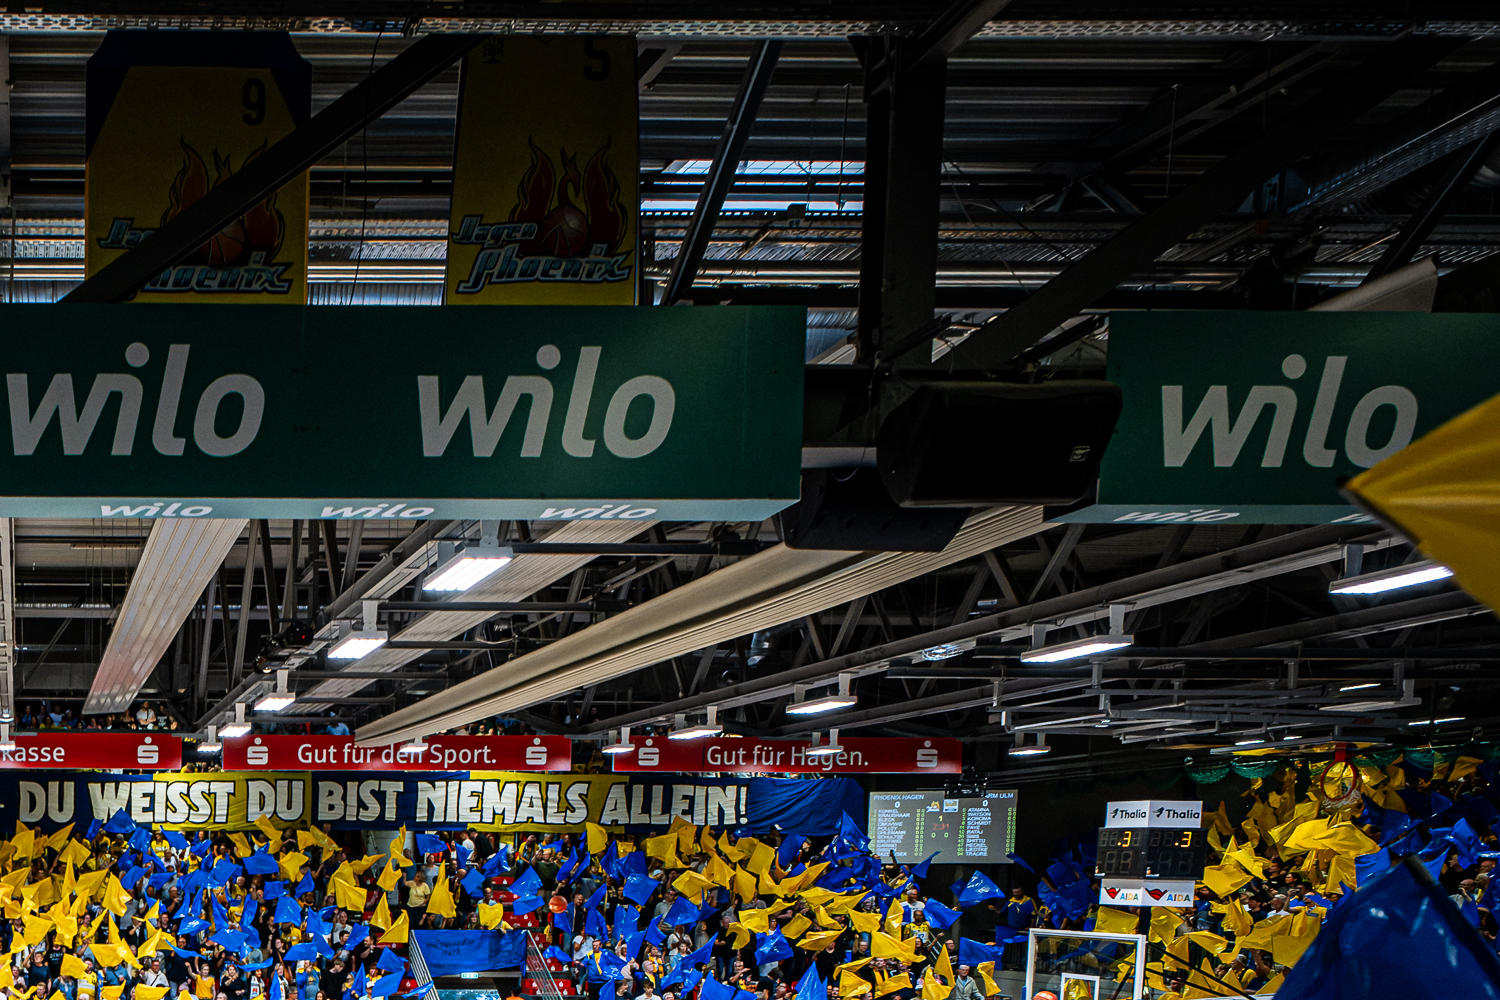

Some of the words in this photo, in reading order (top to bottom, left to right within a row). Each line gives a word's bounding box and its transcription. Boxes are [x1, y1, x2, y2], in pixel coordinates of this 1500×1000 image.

[242, 78, 266, 126] 9
[451, 215, 538, 248] Hagen
[456, 242, 633, 293] Phoenix
[6, 342, 265, 457] wilo
[417, 344, 675, 458] wilo
[1162, 354, 1418, 468] wilo
[100, 501, 214, 518] wilo
[320, 503, 436, 519] wilo
[539, 503, 658, 520] wilo
[1113, 508, 1240, 522] wilo
[298, 743, 337, 764] Gut
[343, 743, 376, 764] für
[382, 743, 422, 764] den
[429, 744, 496, 768] Sport.
[707, 746, 747, 765] Gut
[753, 745, 784, 765] für
[792, 746, 868, 770] Hagen.
[19, 780, 76, 823] DU
[88, 780, 234, 823] WEISST
[248, 779, 304, 823] DU
[318, 779, 404, 821] BIST
[417, 780, 589, 824] NIEMALS
[600, 784, 747, 826] ALLEIN!
[1120, 809, 1147, 819] Thalia
[1165, 809, 1200, 819] Thalia
[1120, 893, 1139, 901] AIDA
[1166, 894, 1191, 902] AIDA
